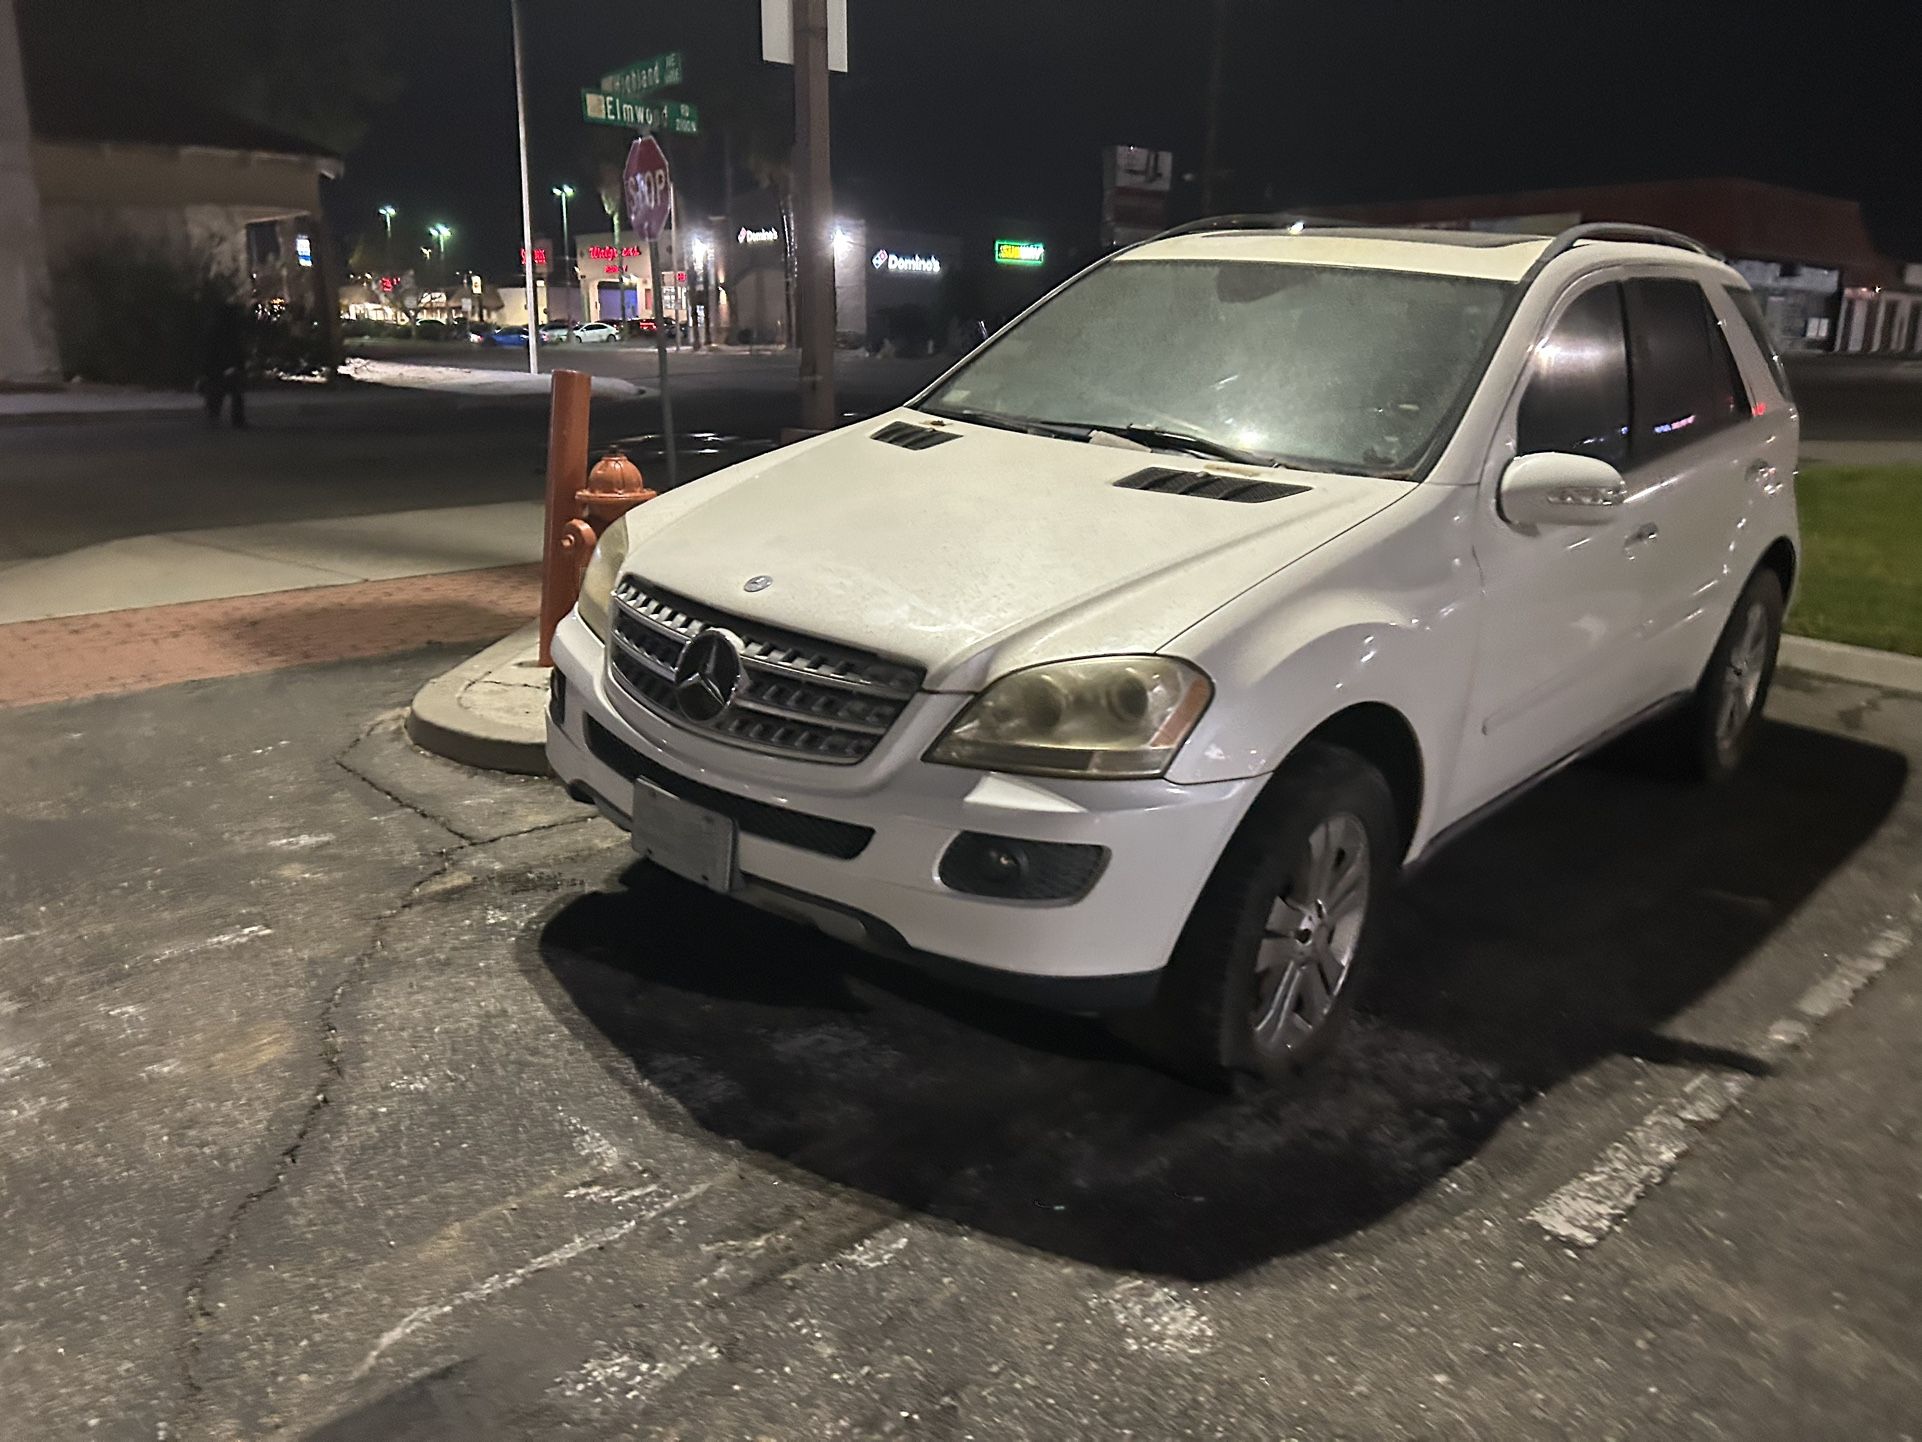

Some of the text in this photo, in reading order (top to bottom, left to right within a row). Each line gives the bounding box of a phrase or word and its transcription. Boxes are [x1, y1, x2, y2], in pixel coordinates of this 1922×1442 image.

[605, 96, 668, 128] Elmwod
[628, 169, 665, 212] STOP
[589, 246, 640, 261] Walgrens
[888, 254, 941, 273] Domino's
